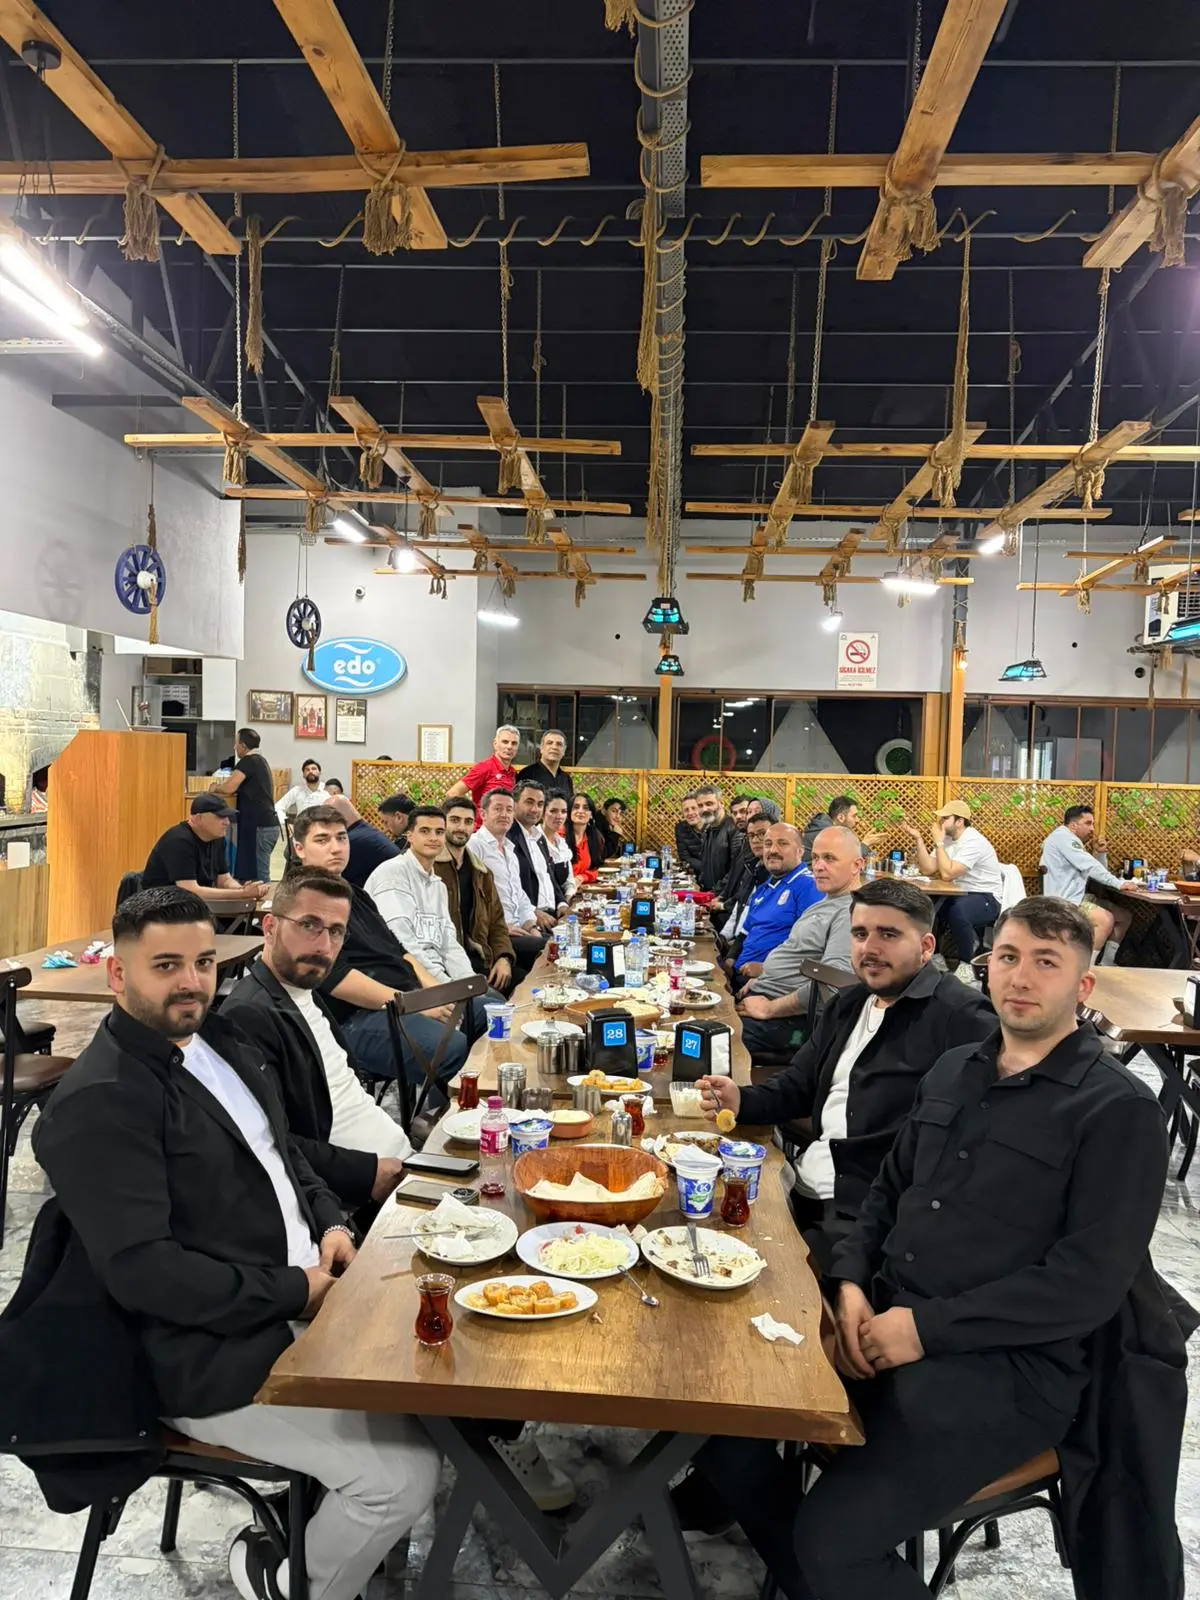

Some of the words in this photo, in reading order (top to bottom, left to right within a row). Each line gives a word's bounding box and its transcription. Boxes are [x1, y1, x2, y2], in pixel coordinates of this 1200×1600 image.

[333, 655, 376, 675] edo
[606, 1028, 624, 1039] 28
[685, 1038, 698, 1050] 27
